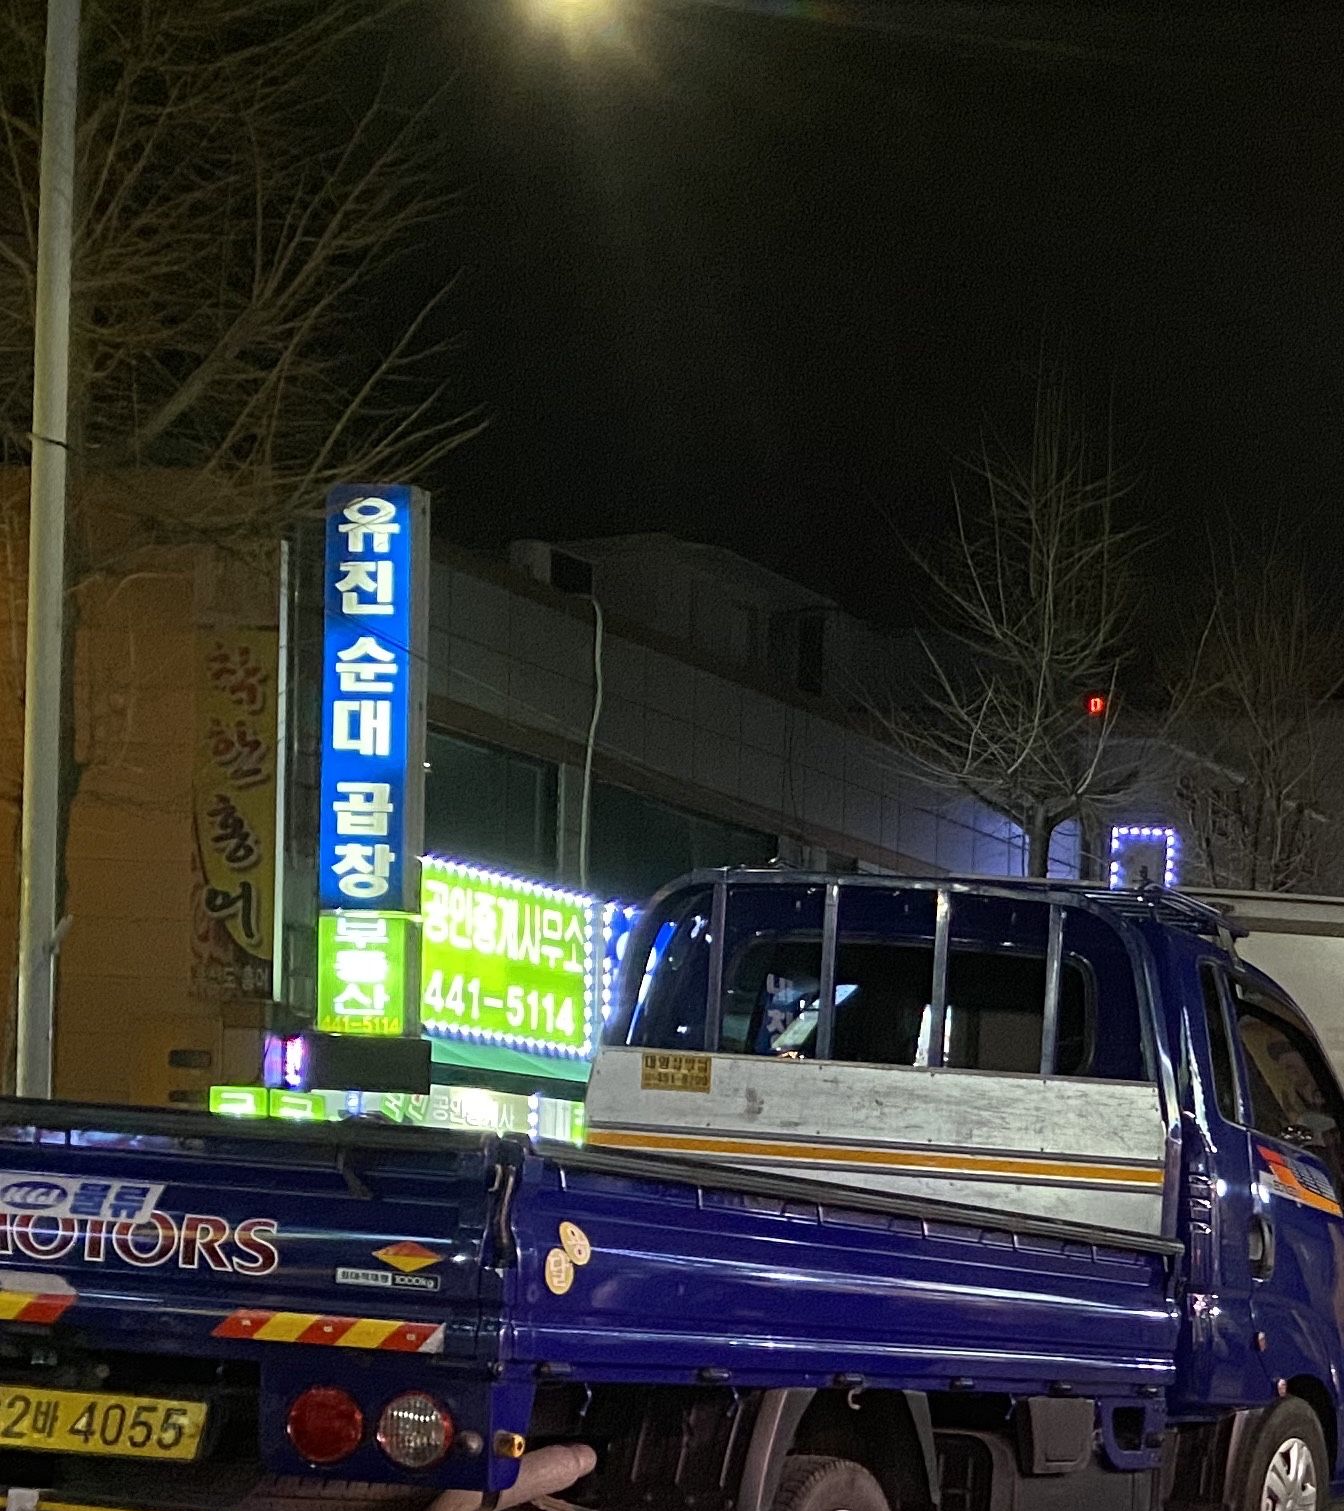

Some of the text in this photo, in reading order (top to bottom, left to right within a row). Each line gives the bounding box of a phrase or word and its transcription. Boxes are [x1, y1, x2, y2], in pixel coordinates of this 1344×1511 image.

[330, 496, 401, 899] 유진 순대 곱창
[425, 878, 584, 974] 공인중개사무소
[321, 1015, 400, 1035] 441-5114
[423, 968, 577, 1037] 441-5114
[0, 1209, 279, 1276] OTORS
[394, 1274, 436, 1290] 1000kg
[67, 1401, 189, 1450] 4055
